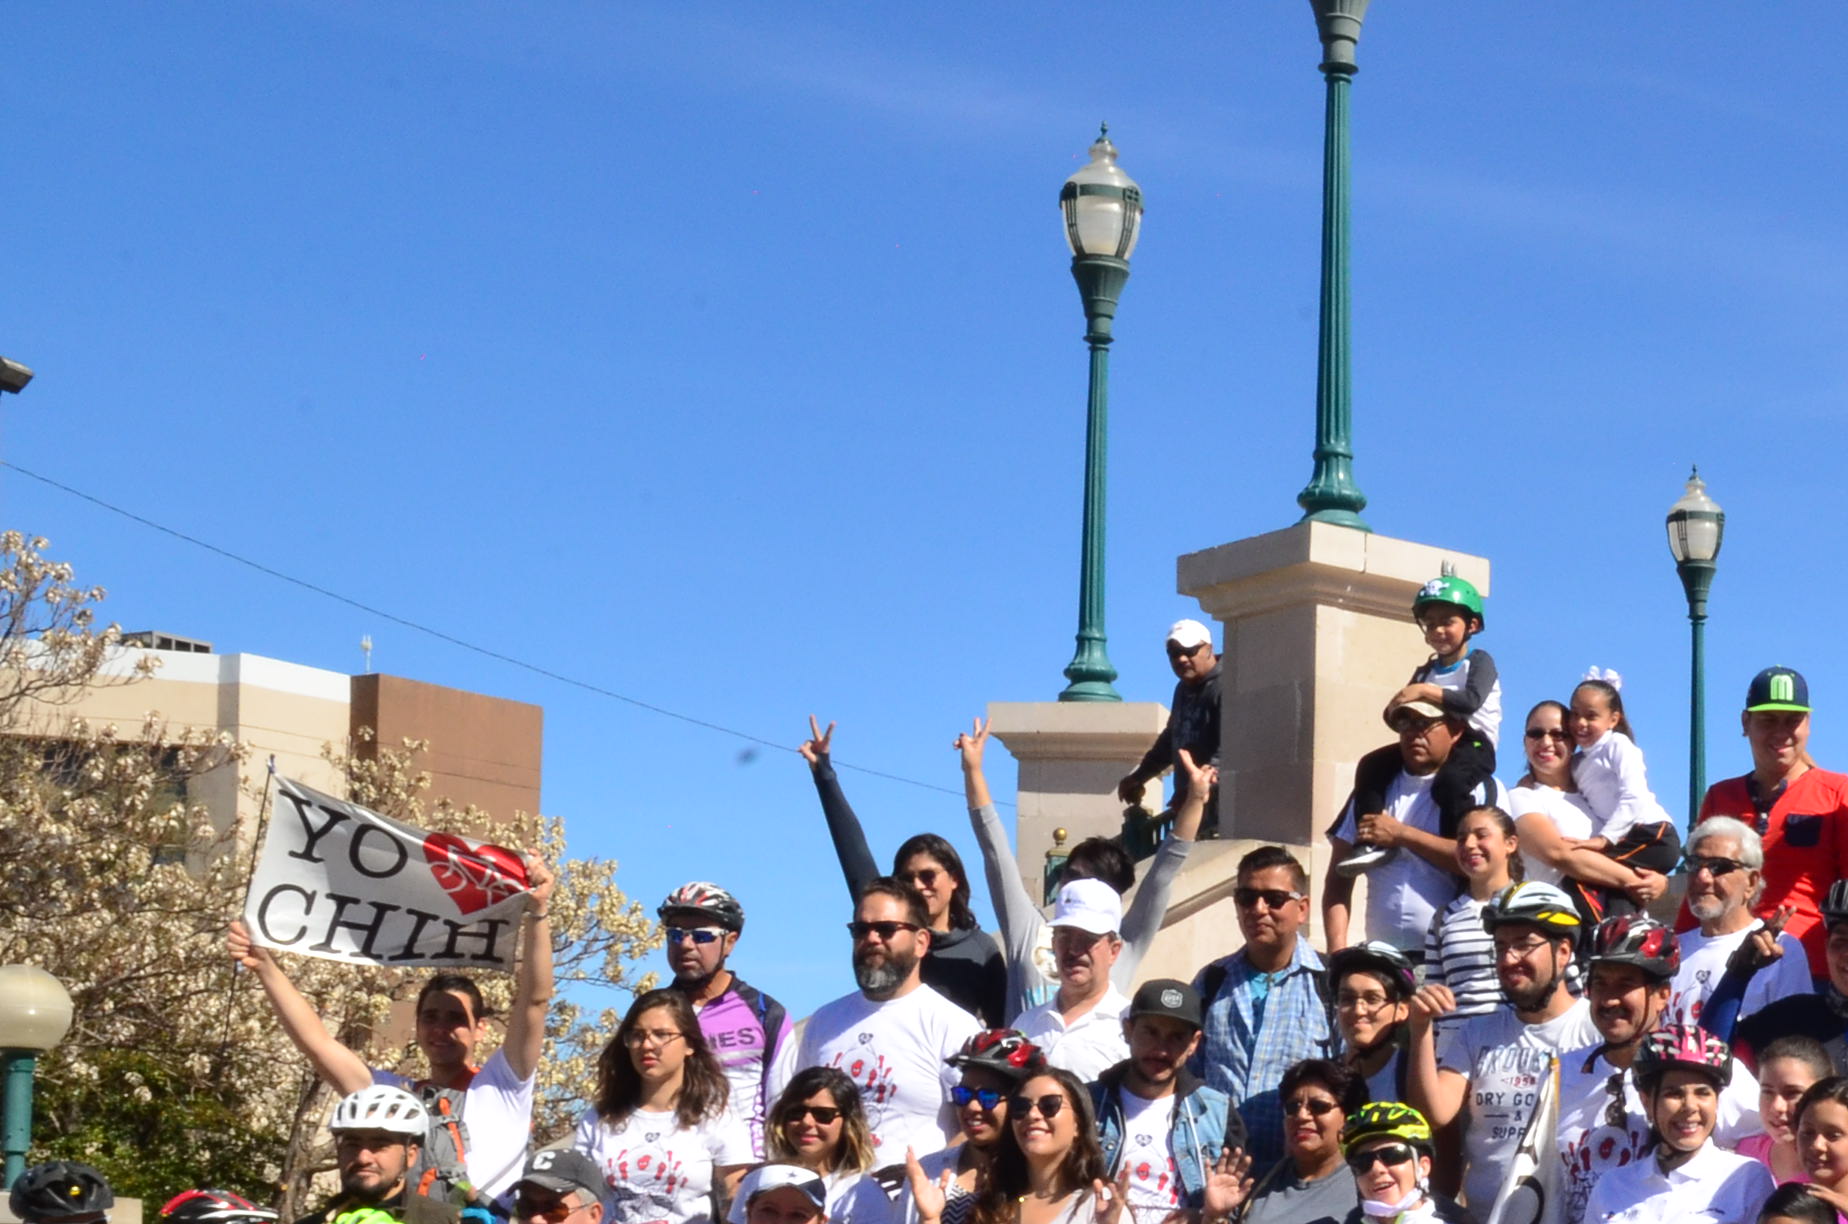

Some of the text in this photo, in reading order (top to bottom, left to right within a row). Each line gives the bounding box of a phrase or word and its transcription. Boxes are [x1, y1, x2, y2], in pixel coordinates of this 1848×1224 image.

[278, 788, 409, 879] YO
[257, 883, 511, 964] CHIH
[1475, 1091, 1505, 1107] DRY
[532, 1151, 556, 1171] C
